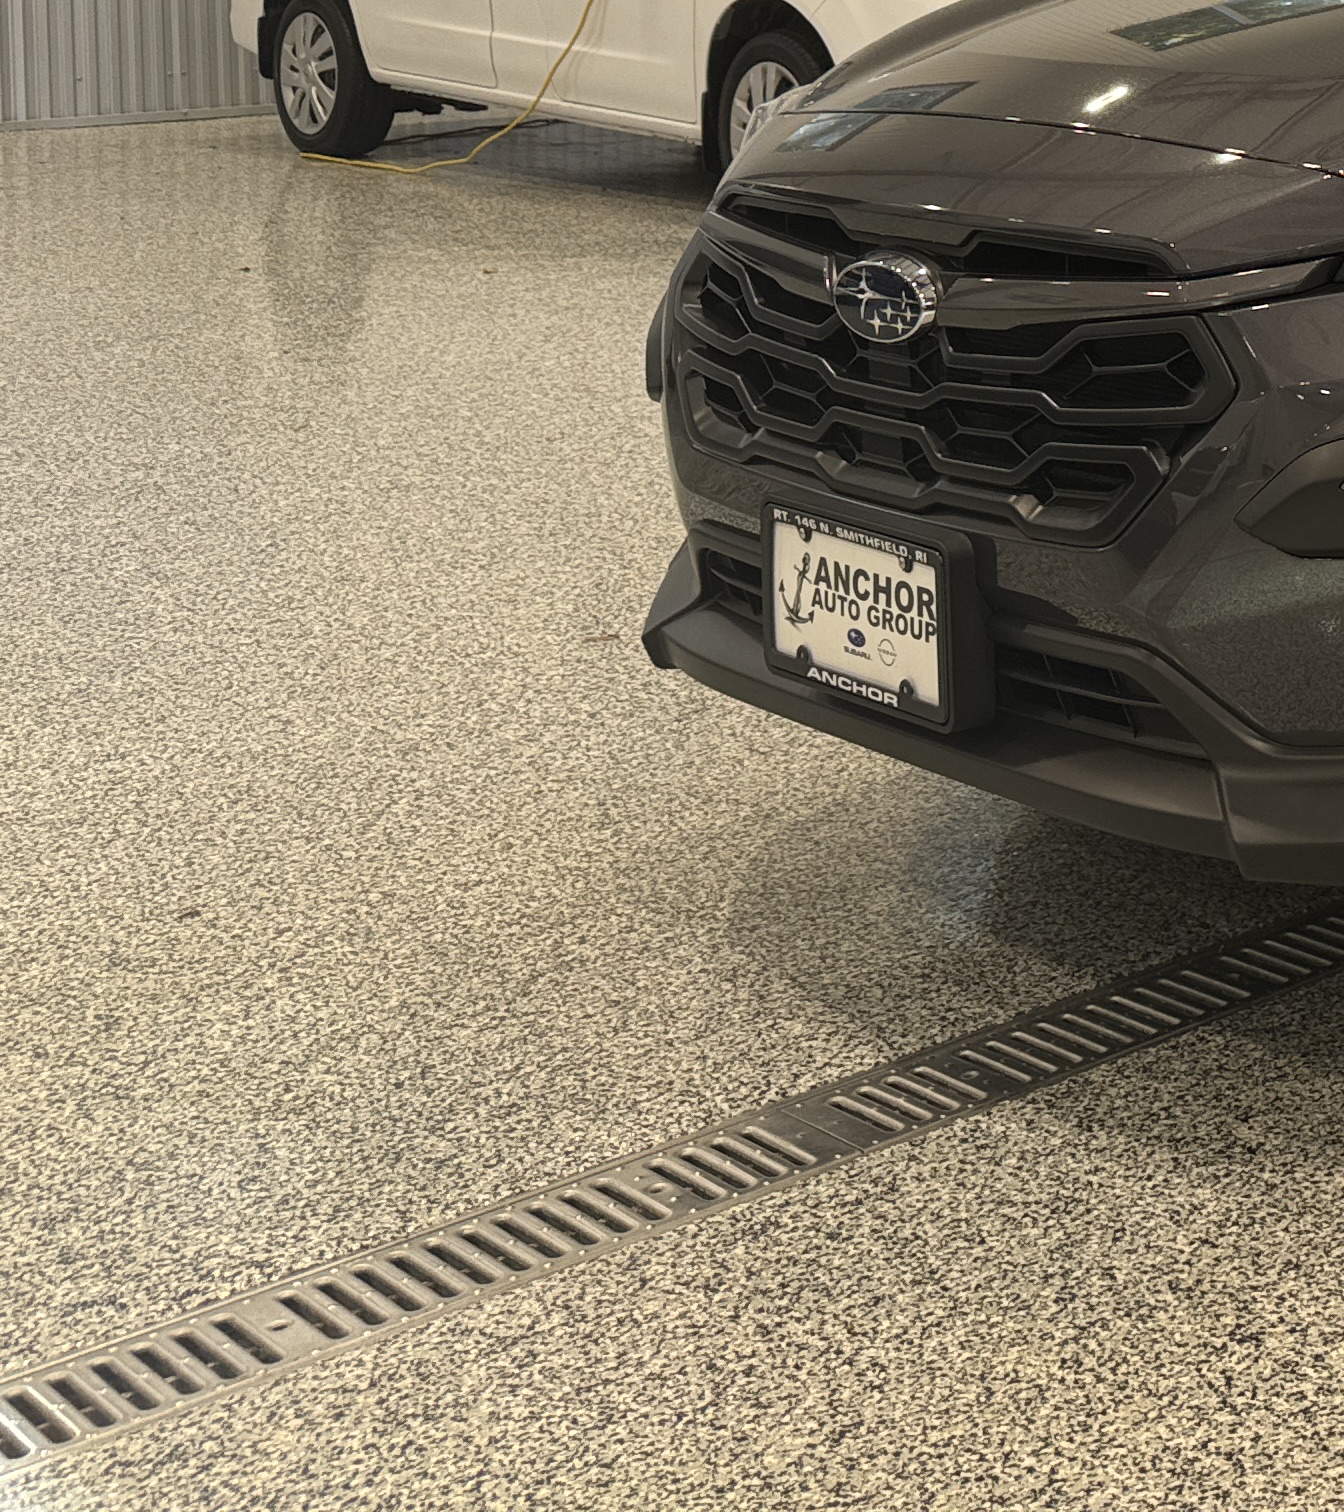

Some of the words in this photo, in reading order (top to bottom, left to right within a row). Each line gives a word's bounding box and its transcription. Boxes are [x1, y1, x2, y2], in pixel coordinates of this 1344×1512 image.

[773, 508, 791, 523] RT.
[794, 514, 817, 530] 146
[819, 522, 834, 535] N.
[835, 526, 913, 560] SMITHFIELD,
[915, 550, 928, 564] RI
[811, 587, 860, 621] AUTO
[867, 604, 937, 643] GROUP
[813, 556, 936, 621] ANCHOR
[806, 667, 899, 708] ANCHOR
